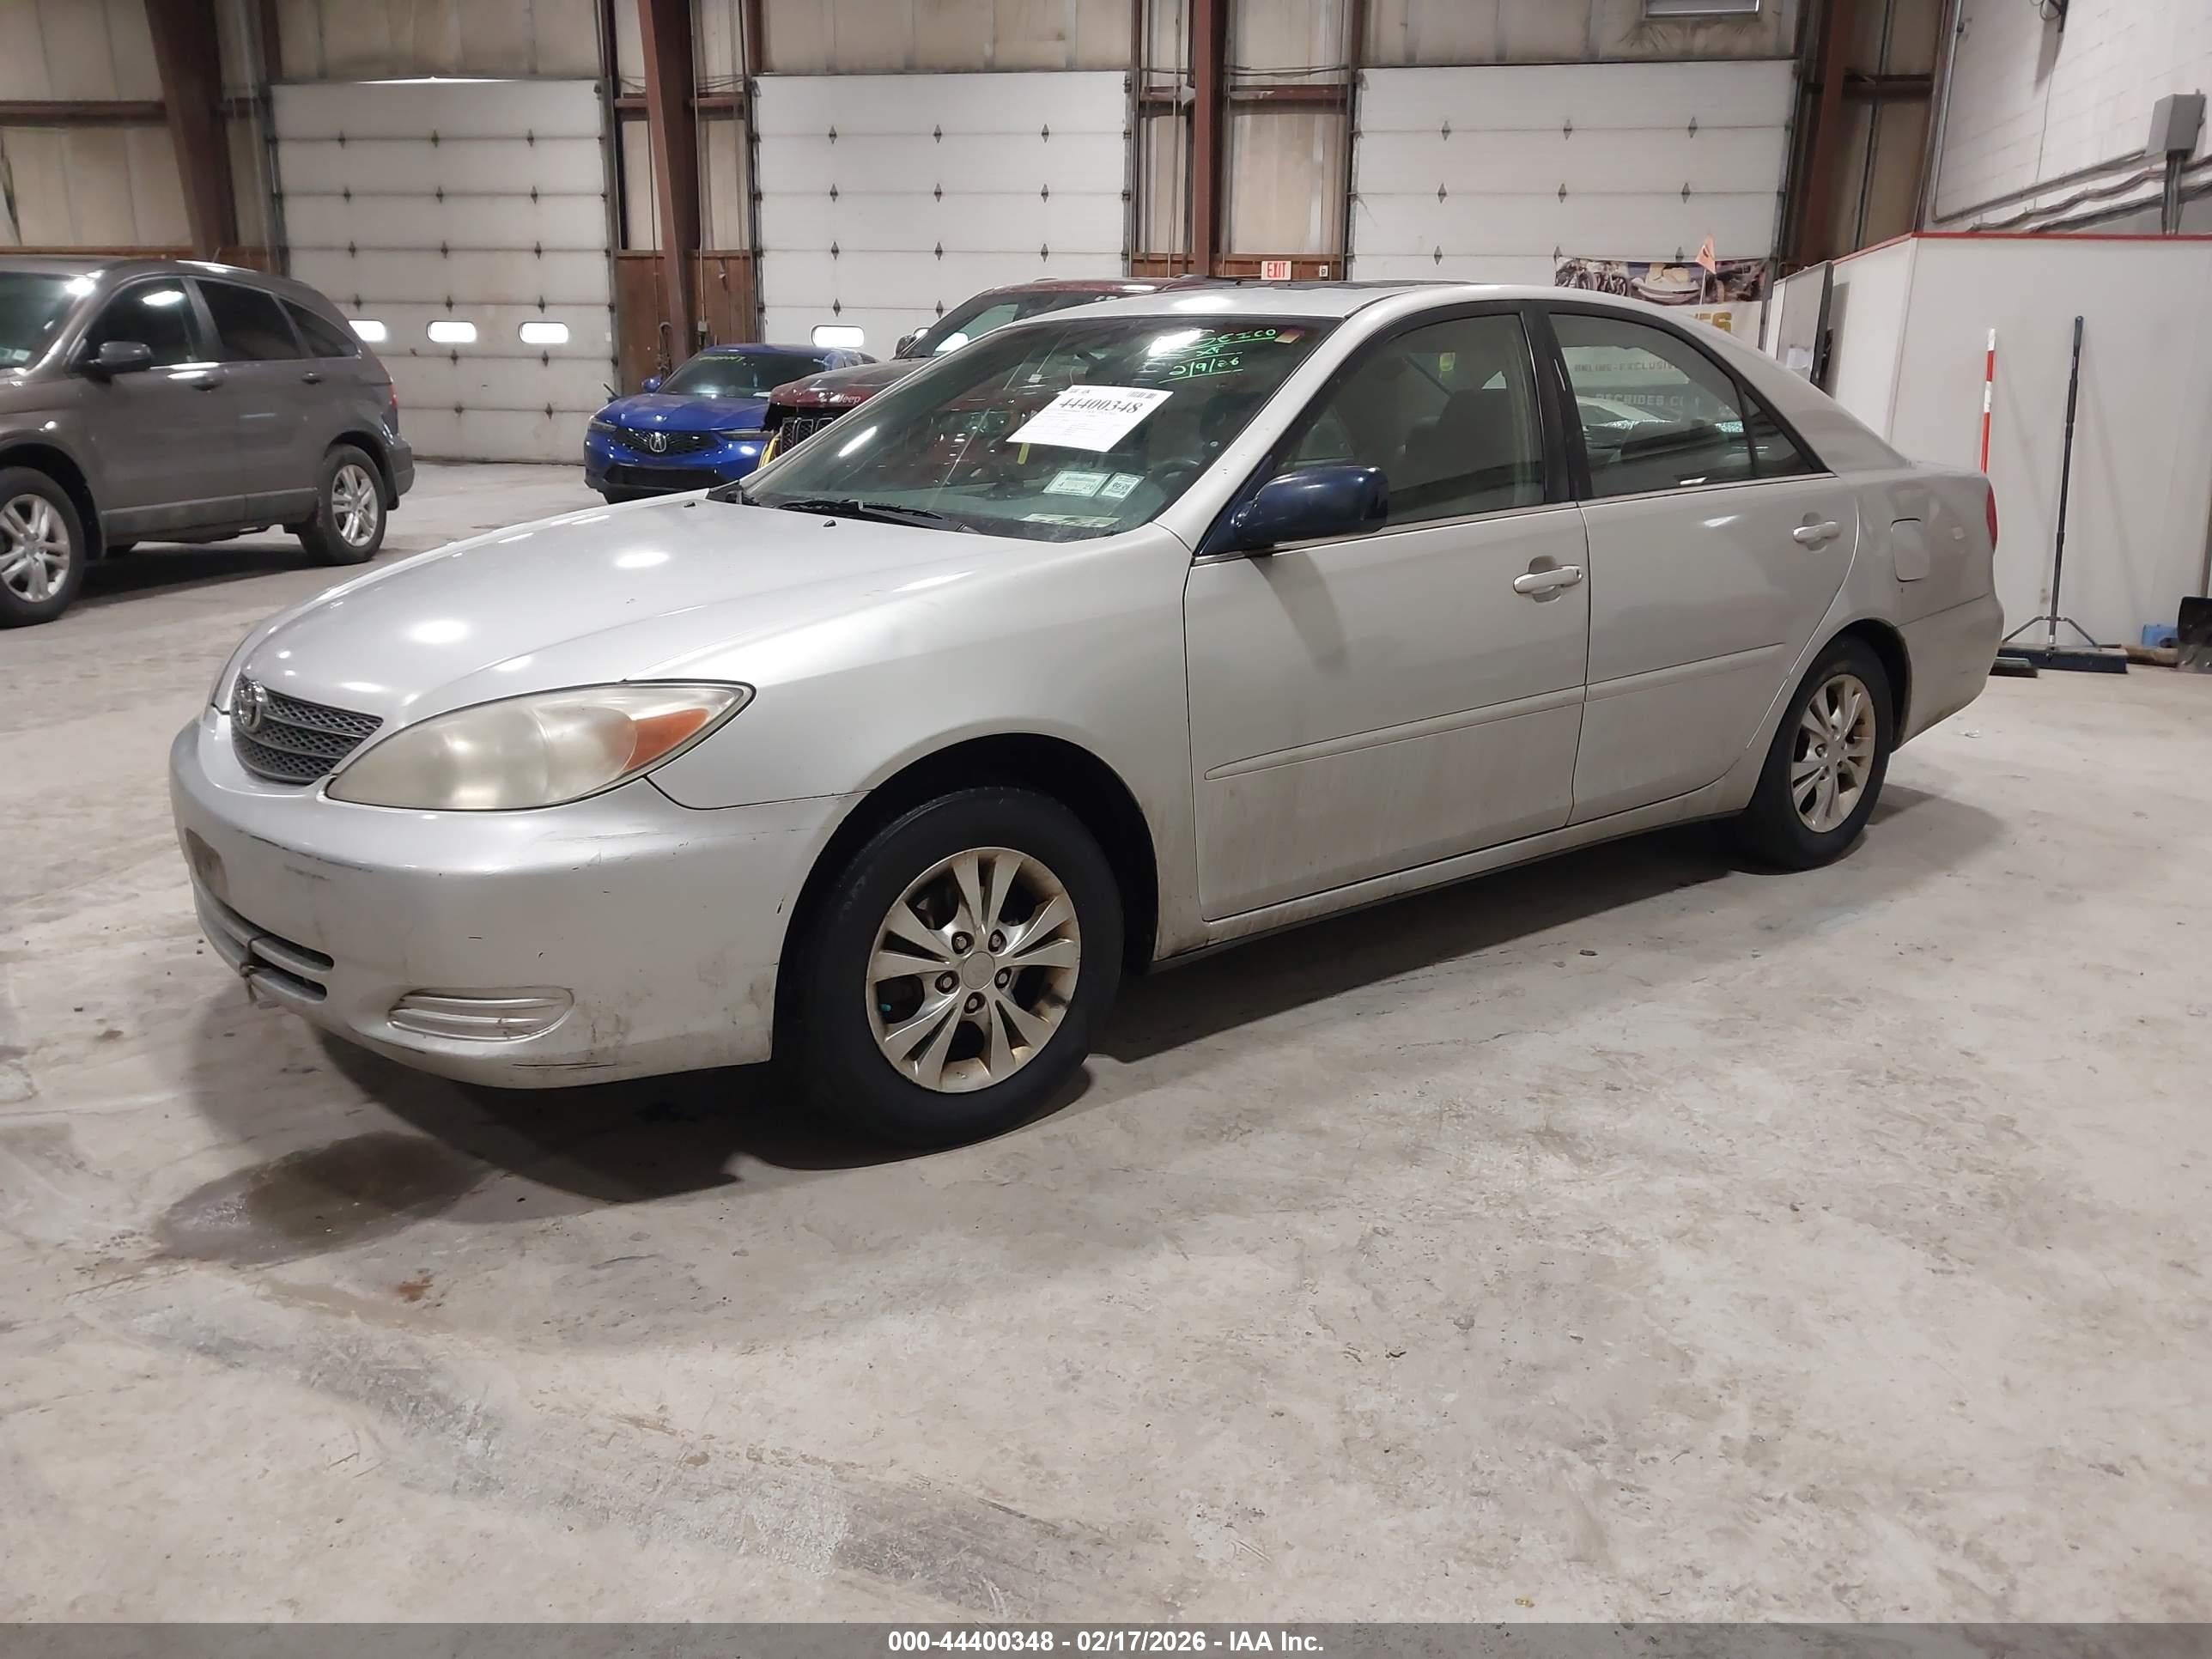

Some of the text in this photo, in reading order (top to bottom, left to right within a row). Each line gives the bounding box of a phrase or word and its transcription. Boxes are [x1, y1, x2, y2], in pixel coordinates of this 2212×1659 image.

[1267, 262, 1286, 277] EXIT
[838, 393, 861, 404] Jeep
[1059, 398, 1144, 413] 44400348
